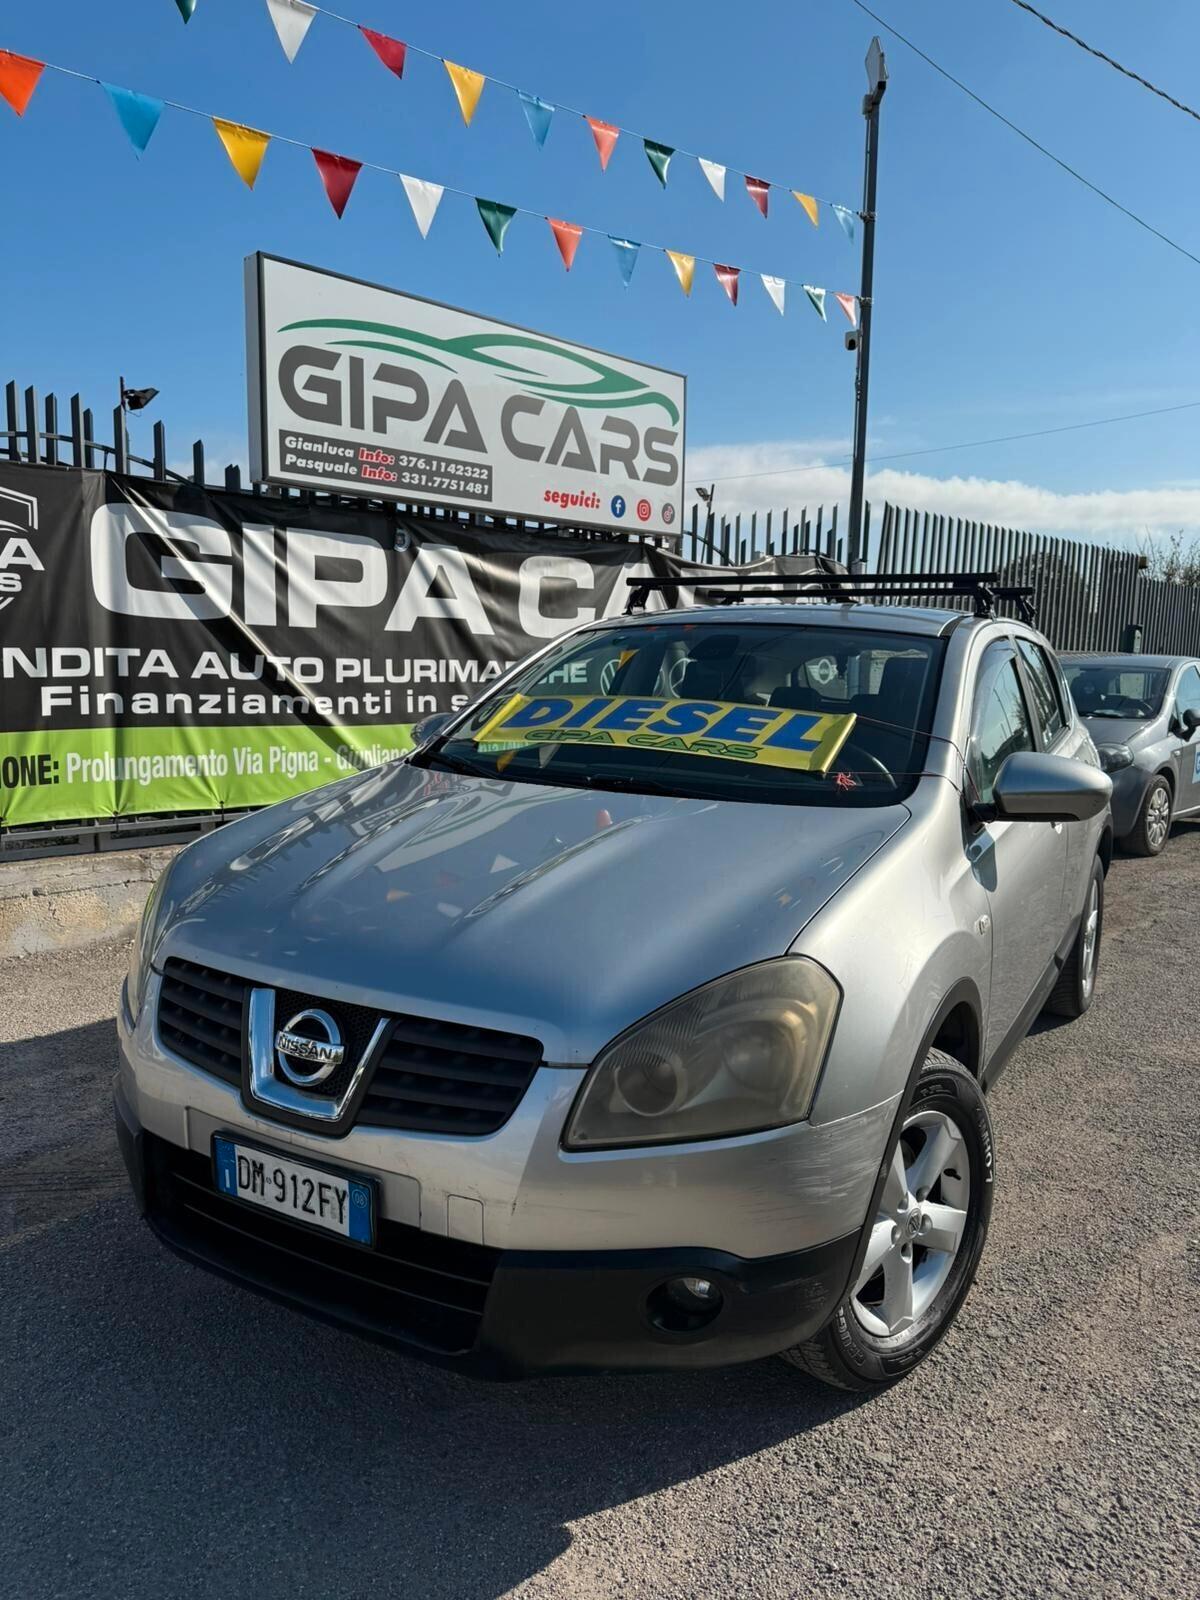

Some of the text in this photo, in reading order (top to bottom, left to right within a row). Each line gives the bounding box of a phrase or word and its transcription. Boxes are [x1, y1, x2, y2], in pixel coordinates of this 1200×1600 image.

[278, 345, 679, 487] GIPA CARS
[284, 436, 489, 480] Gianluca Info: 376.1142322
[285, 453, 489, 495] Pasquale Info: 331.7751481
[543, 490, 601, 509] seguici:
[90, 502, 494, 635] GIPA
[191, 651, 324, 684] AUTO
[336, 657, 588, 685] PLURIMAHE
[41, 686, 391, 717] Finanziamenti
[407, 689, 437, 713] in
[500, 697, 824, 753] DIESEL
[524, 729, 763, 760] GIPA CARS
[0, 752, 59, 789] ONE:
[66, 751, 228, 786] Prolungamento
[234, 747, 264, 776] Via
[269, 745, 319, 780] Pigna
[278, 1033, 333, 1060] NISSAN
